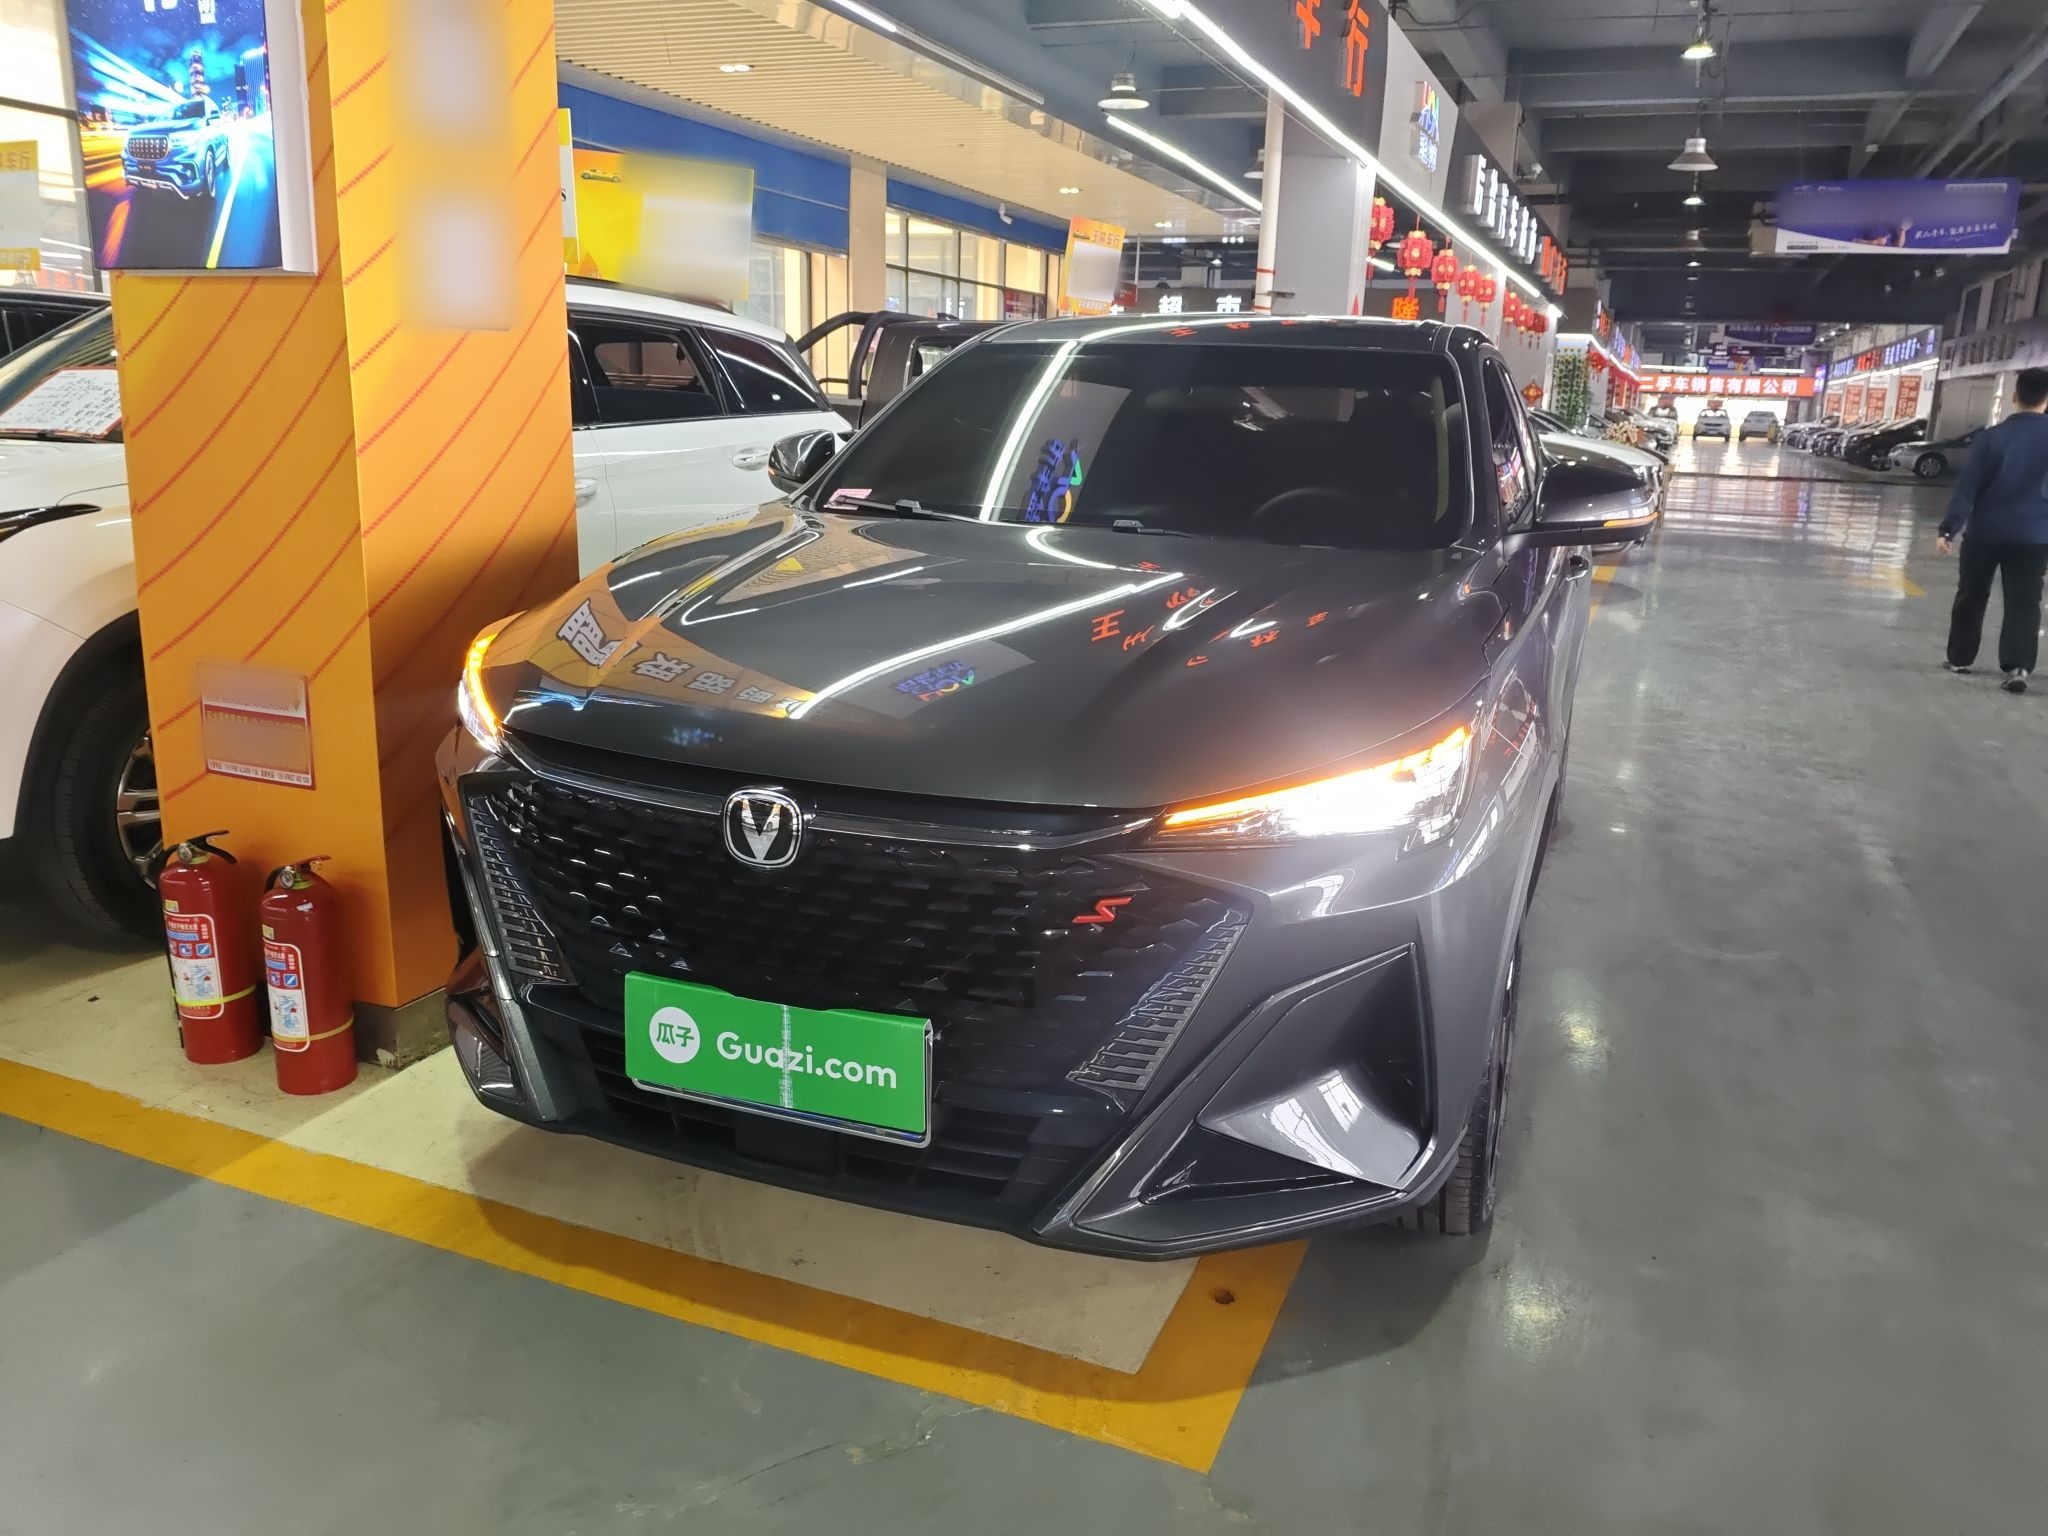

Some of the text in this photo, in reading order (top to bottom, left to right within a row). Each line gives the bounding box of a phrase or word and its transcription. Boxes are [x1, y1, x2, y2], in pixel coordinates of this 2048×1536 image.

[1639, 376, 1798, 395] 二手车销售有限公司
[655, 1022, 695, 1048] 瓜子
[716, 1031, 897, 1089] Guazi.com
